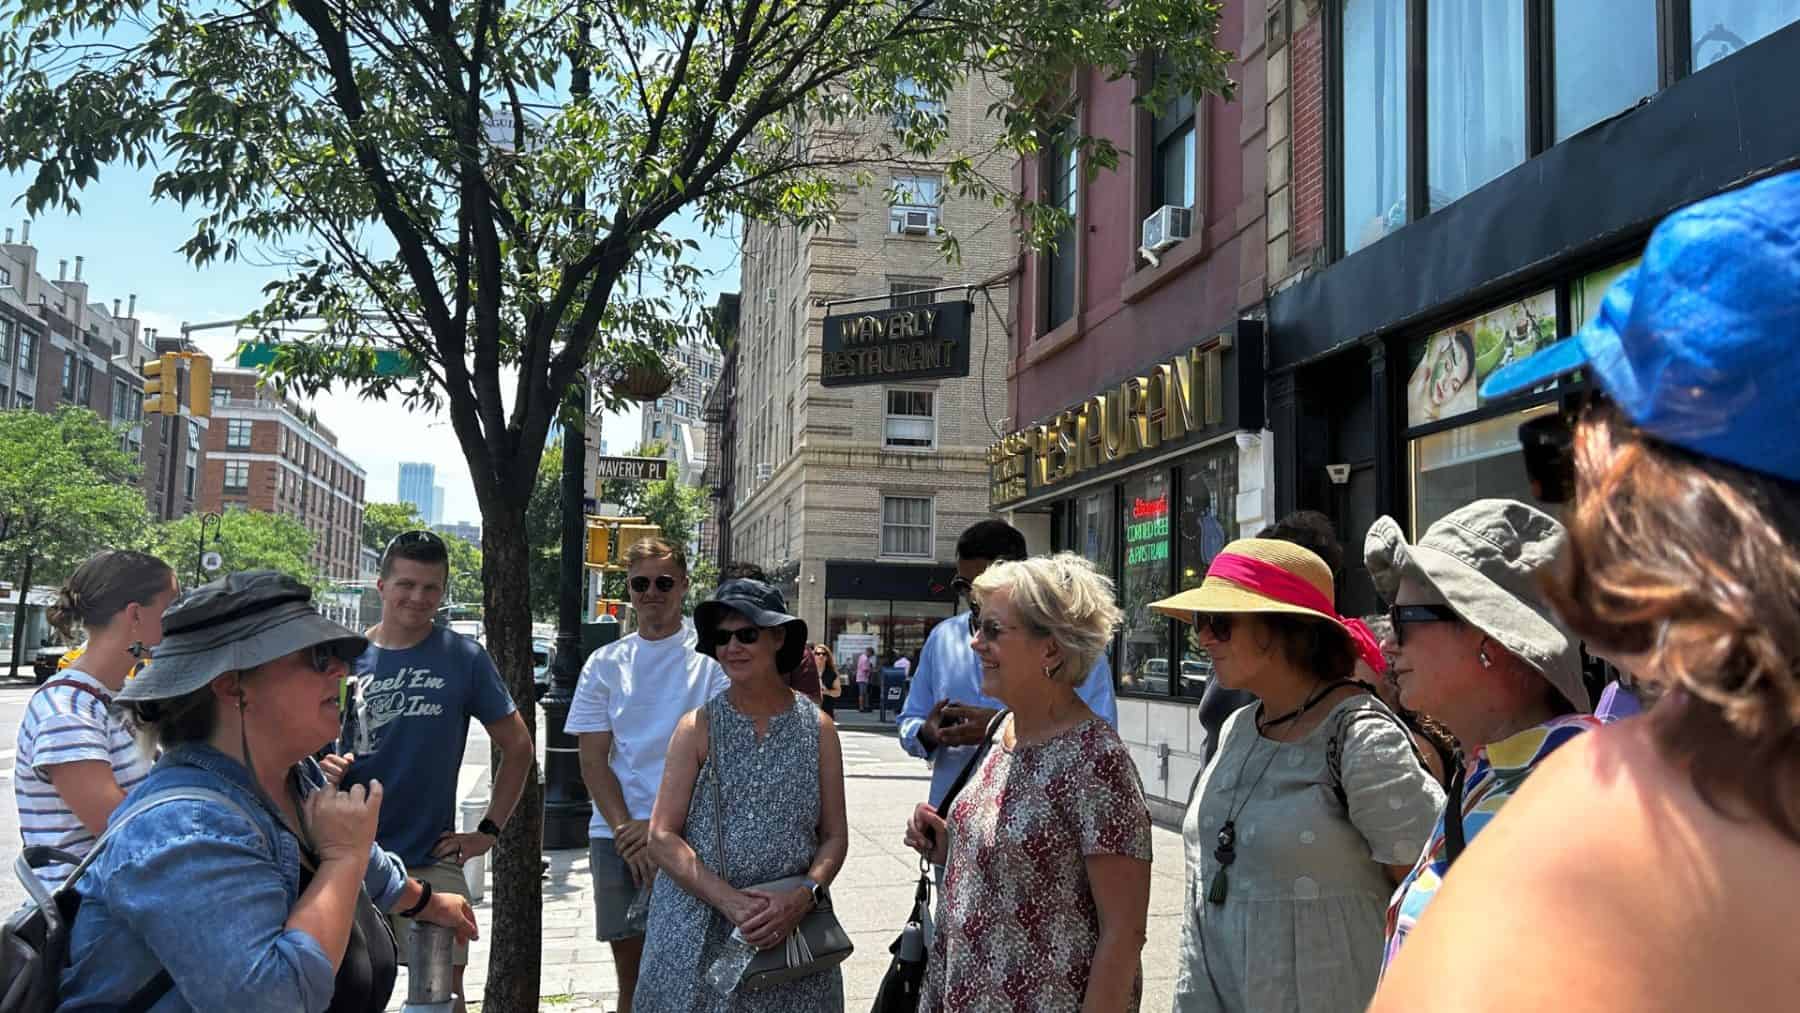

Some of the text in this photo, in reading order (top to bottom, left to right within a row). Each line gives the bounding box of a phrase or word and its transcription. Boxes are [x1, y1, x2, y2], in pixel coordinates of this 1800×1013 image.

[841, 310, 937, 344] WAVERLY
[823, 340, 957, 377] RESTAURANT
[1027, 334, 1231, 486] RESTAURANT
[598, 461, 662, 479] WAVERLY PL
[403, 696, 443, 716] Inn
